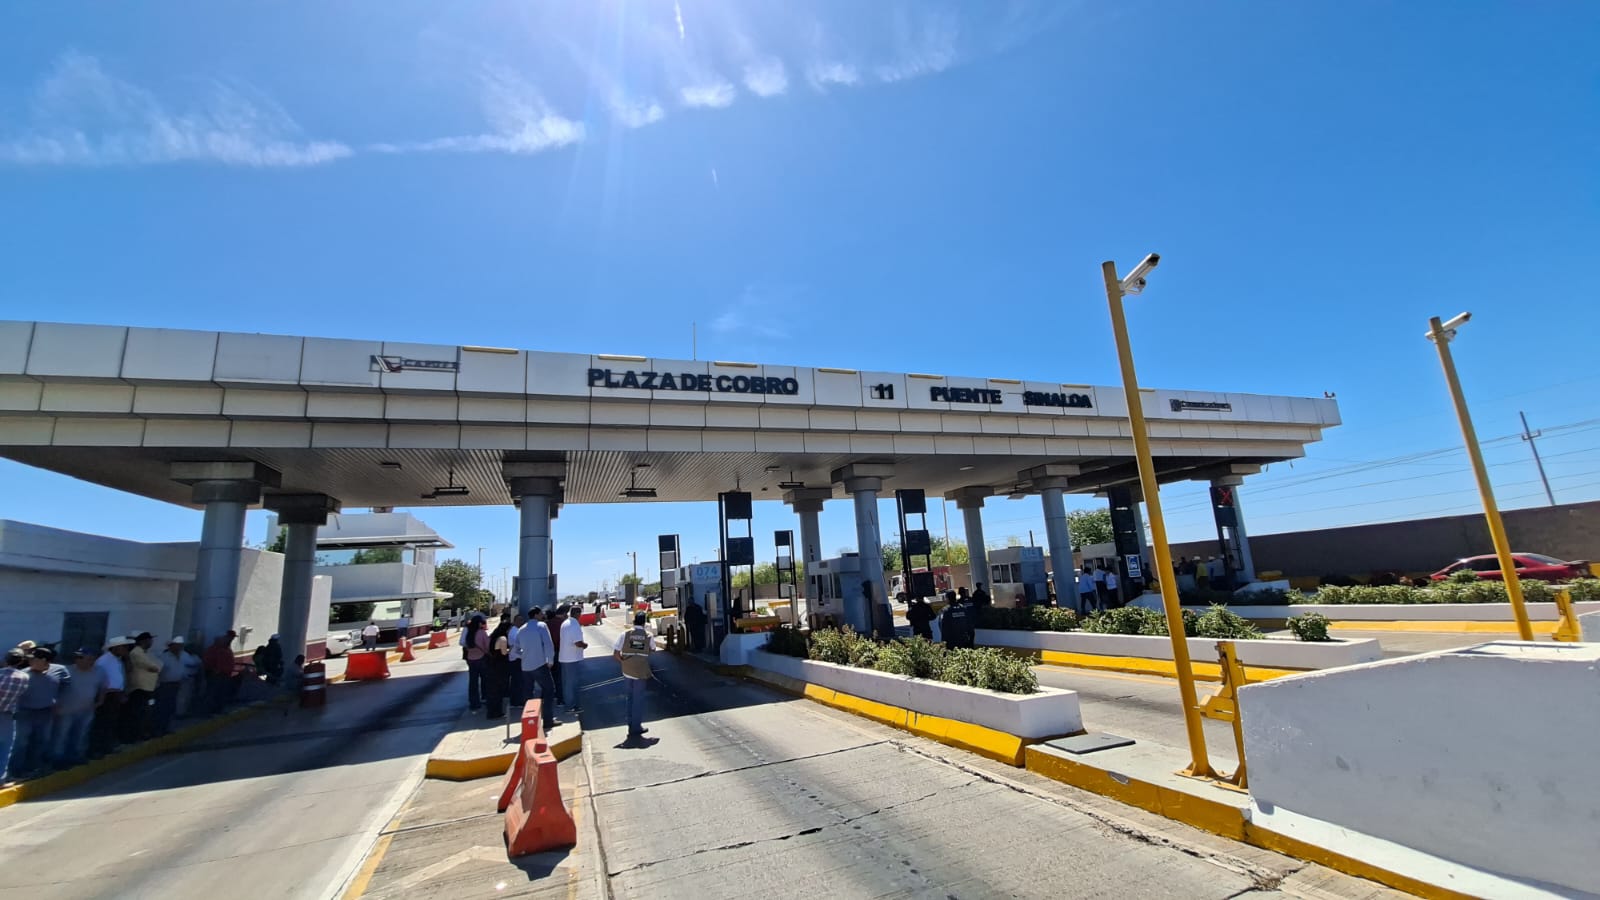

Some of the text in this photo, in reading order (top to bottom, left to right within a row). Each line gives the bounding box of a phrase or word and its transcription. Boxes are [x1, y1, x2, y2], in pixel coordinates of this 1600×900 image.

[588, 368, 1093, 409] PLAZA DE COBRO 11 PUENTE SINALOA
[696, 565, 718, 577] 074
